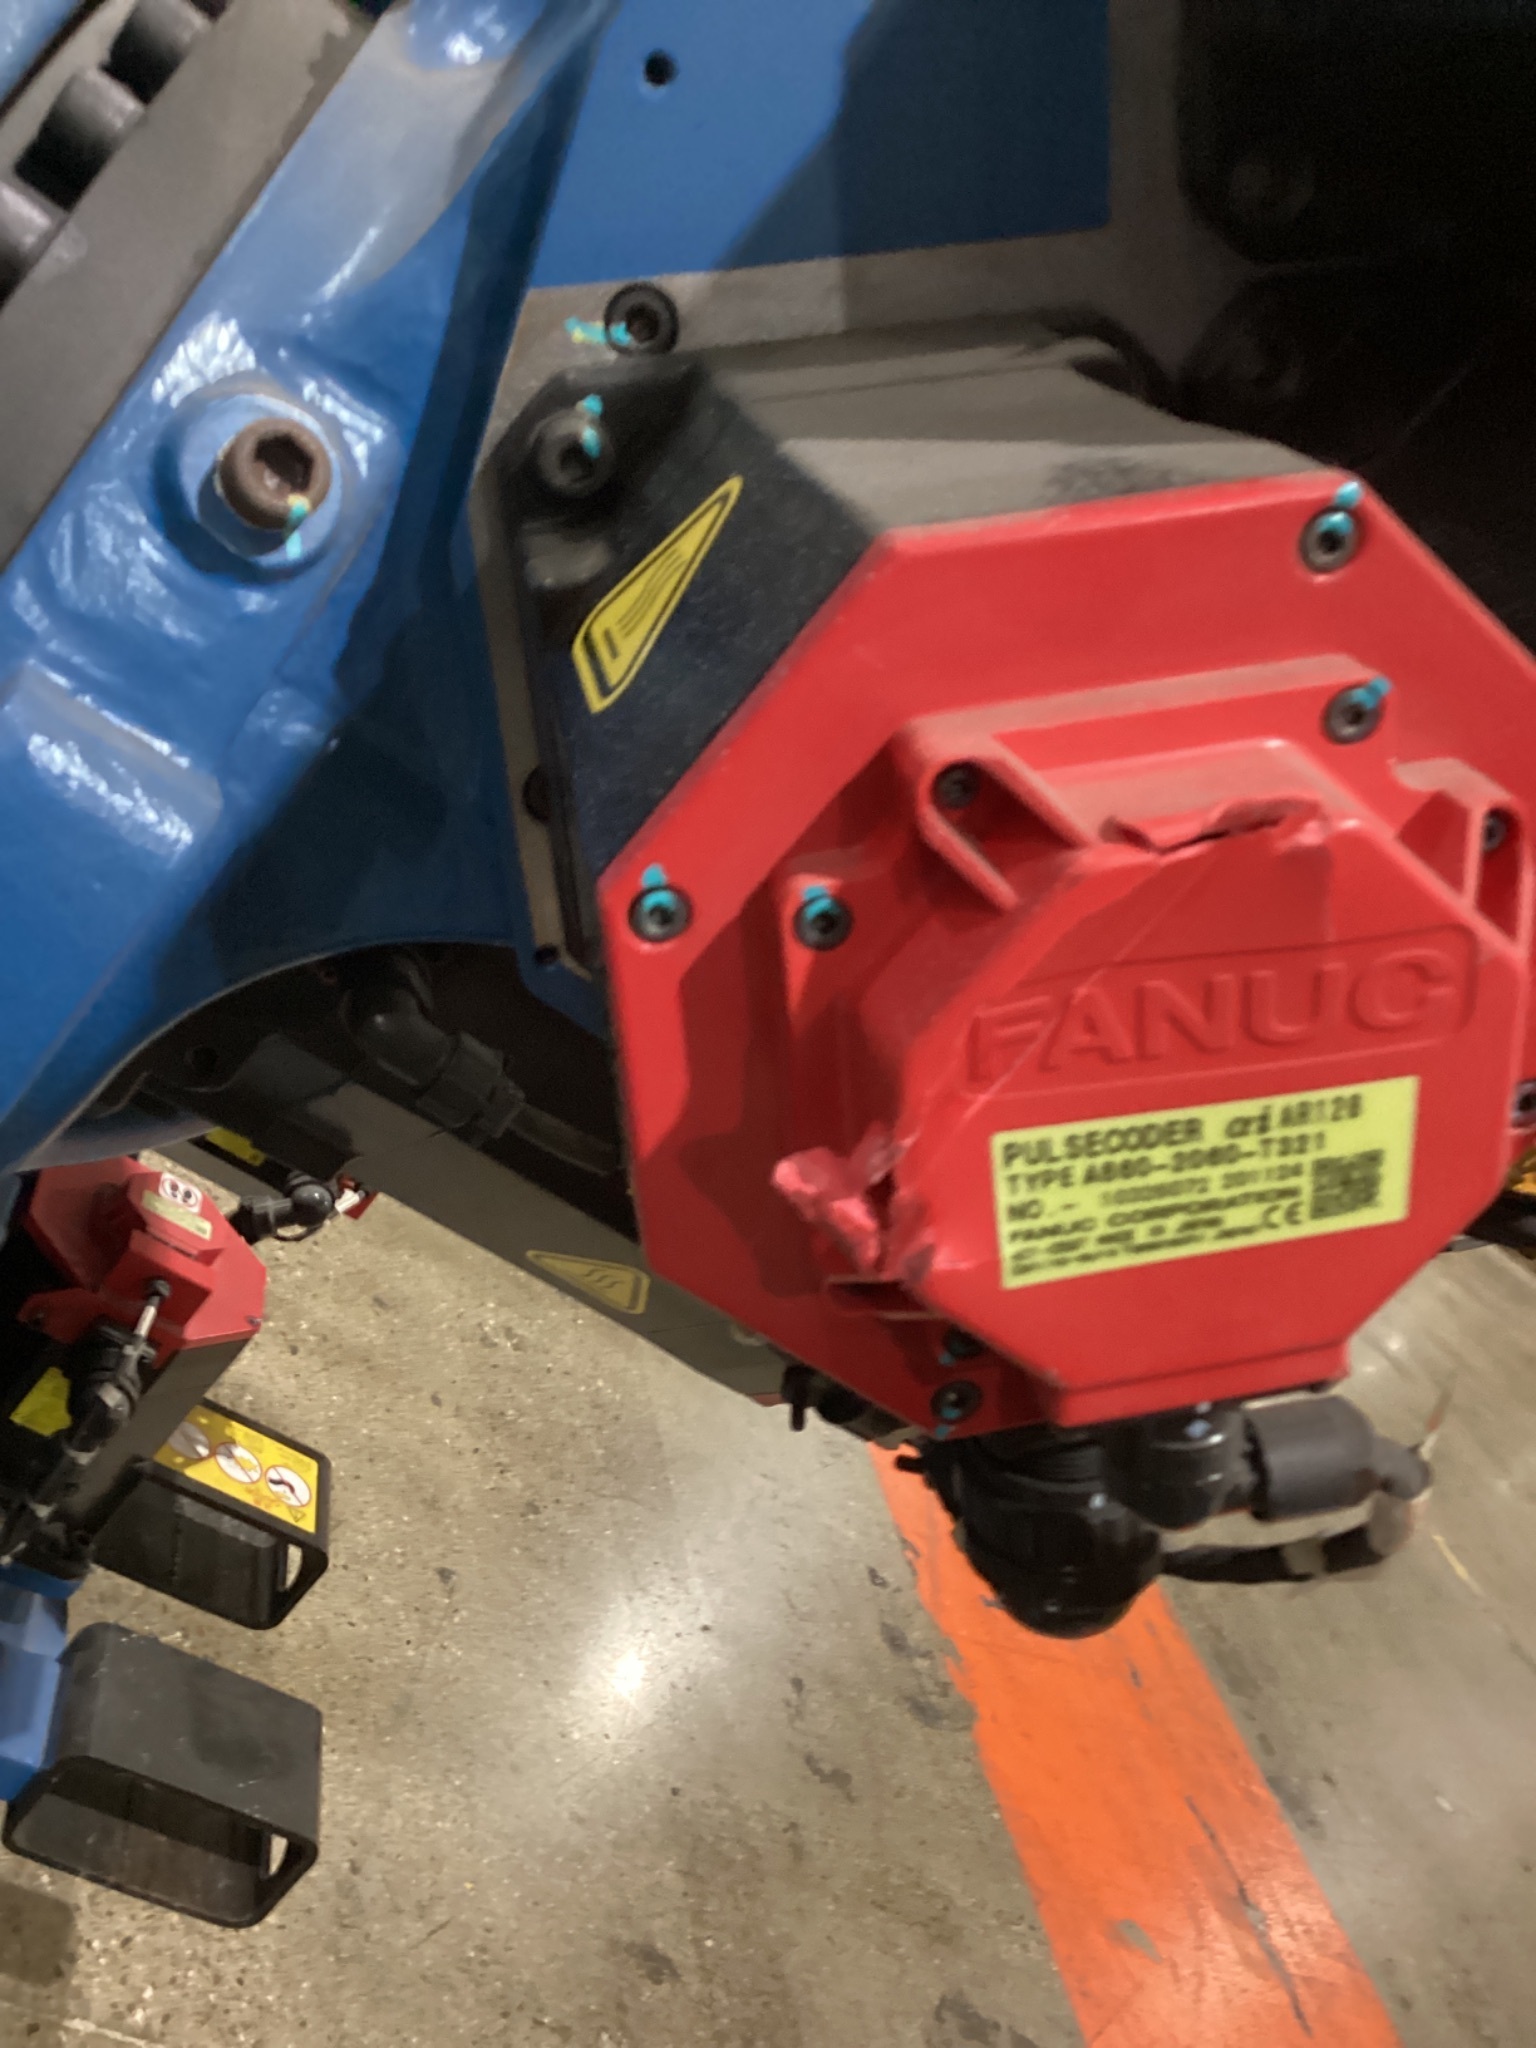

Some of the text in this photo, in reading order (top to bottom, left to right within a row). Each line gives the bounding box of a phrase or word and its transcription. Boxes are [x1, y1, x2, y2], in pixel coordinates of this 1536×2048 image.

[965, 947, 1458, 1082] FANUC
[1002, 1117, 1203, 1167] PULSECODER
[1006, 1166, 1074, 1195] TYPE
